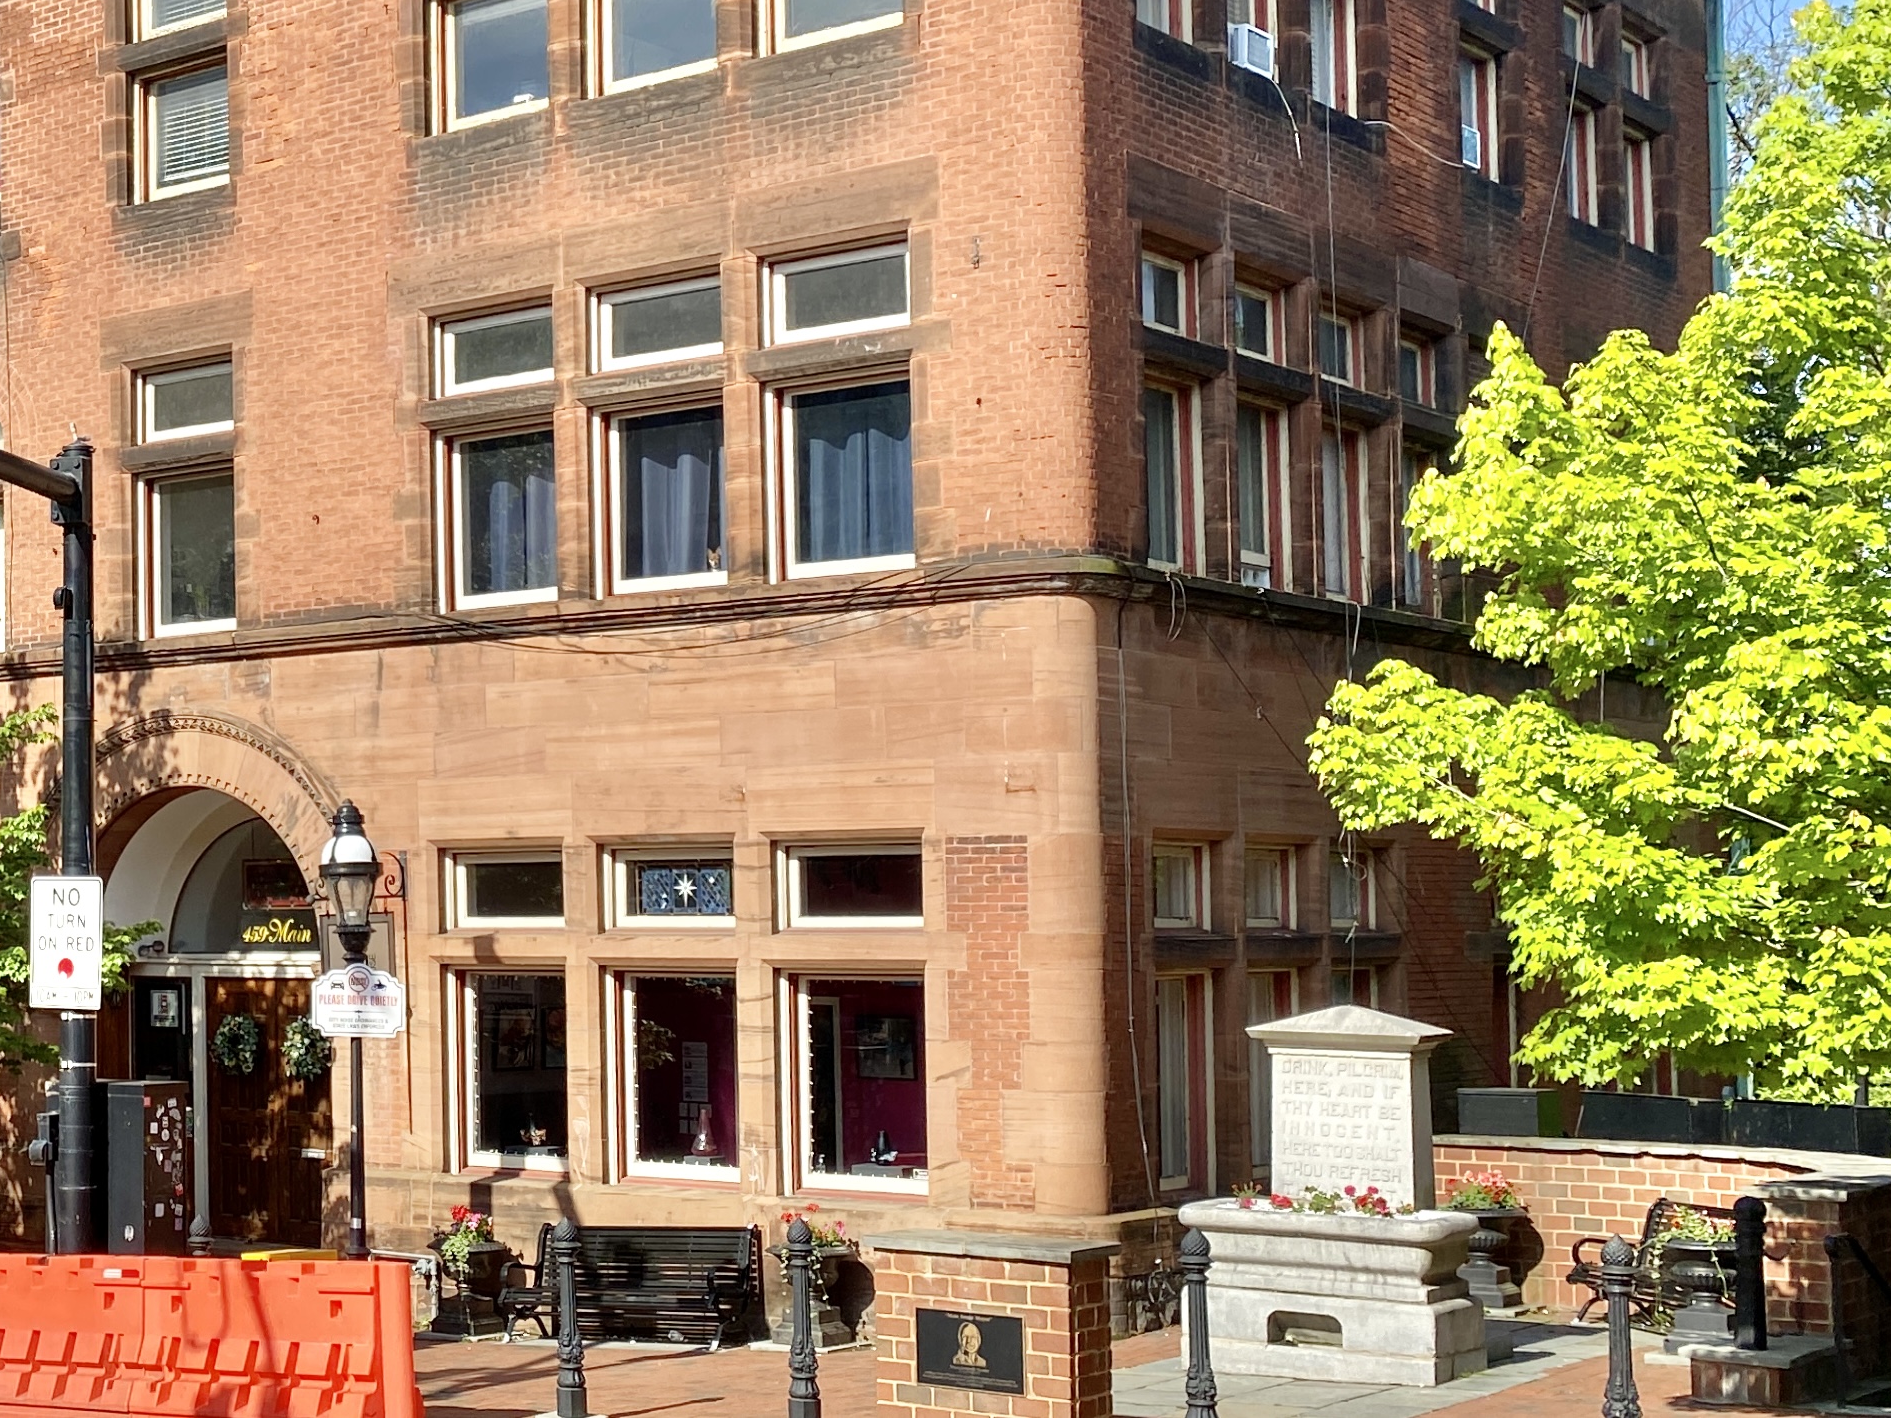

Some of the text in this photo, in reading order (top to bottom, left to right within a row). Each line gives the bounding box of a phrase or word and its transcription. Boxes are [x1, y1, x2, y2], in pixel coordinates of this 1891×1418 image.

[52, 887, 80, 906] NO
[48, 913, 86, 928] TURN
[242, 918, 312, 943] 459 Main
[38, 935, 95, 952] ON RED
[318, 994, 398, 1007] PLEASE DRIVE QUIETLY
[1281, 1059, 1333, 1077] DRINK,
[1336, 1083, 1375, 1099] AND
[1383, 1084, 1402, 1100] IF
[1281, 1100, 1402, 1121] THY HEART BE
[1282, 1140, 1402, 1162] HERE TOO SHALT
[1281, 1160, 1402, 1183] THOU REFRESH
